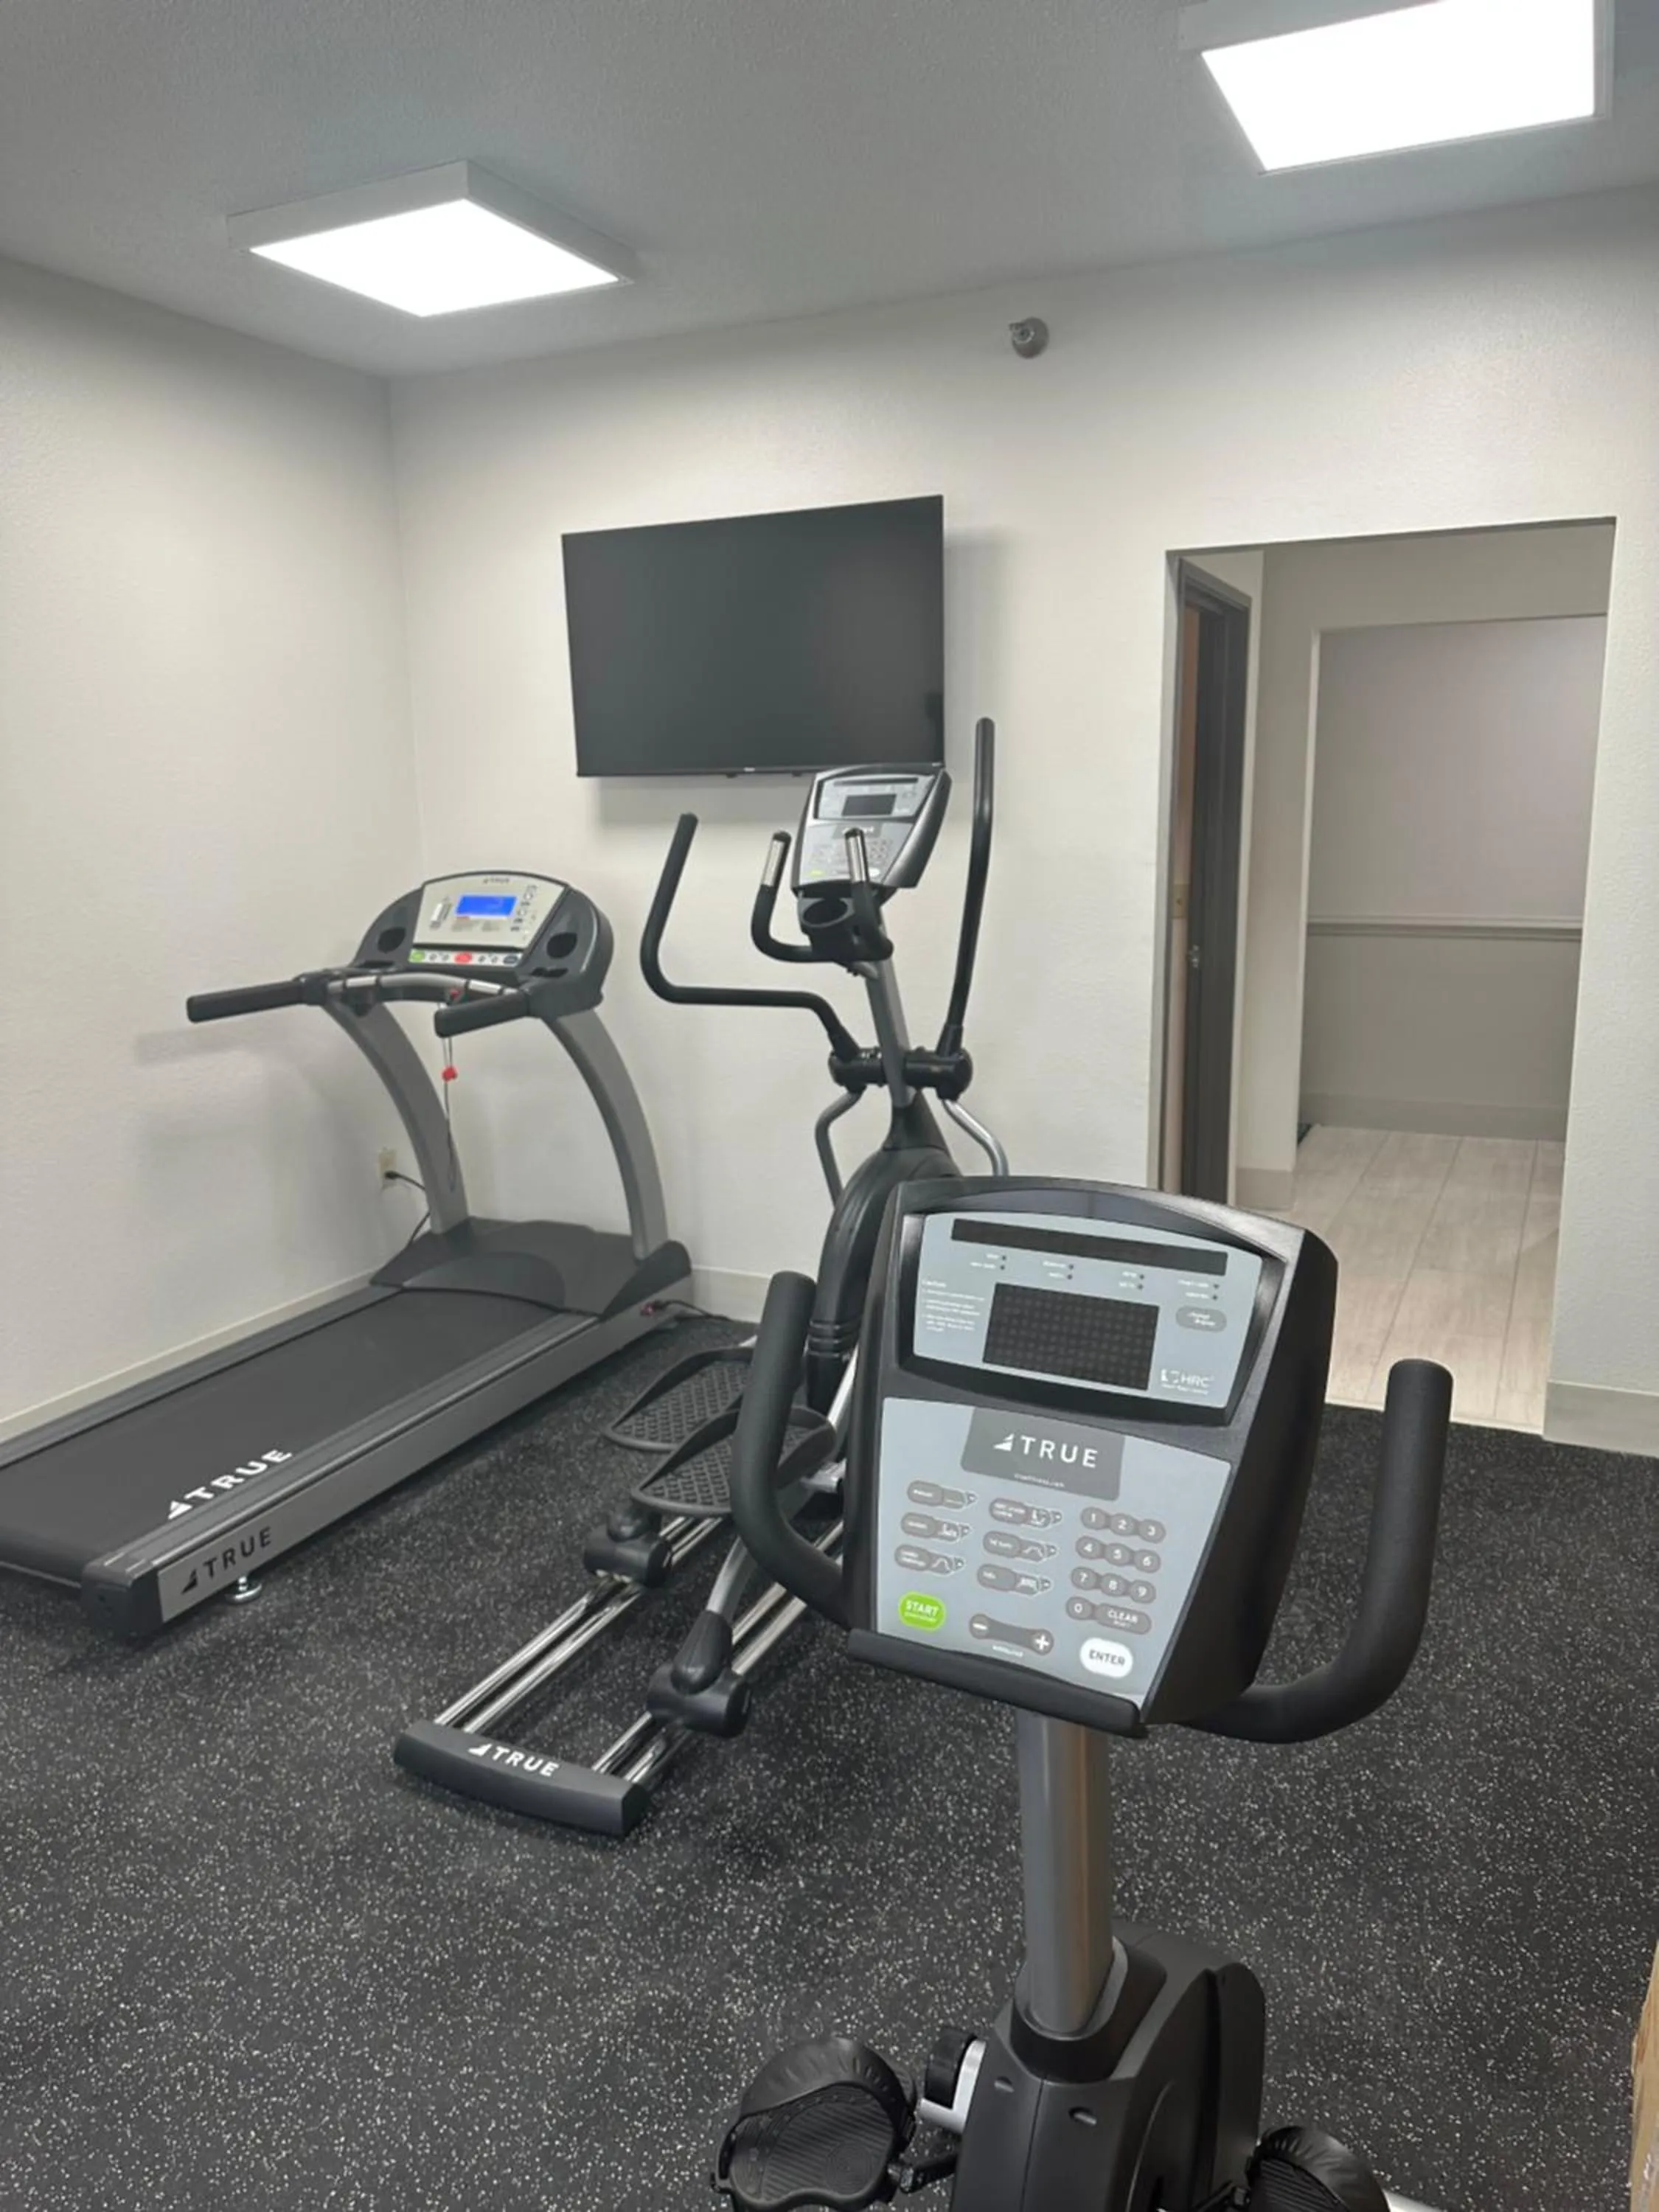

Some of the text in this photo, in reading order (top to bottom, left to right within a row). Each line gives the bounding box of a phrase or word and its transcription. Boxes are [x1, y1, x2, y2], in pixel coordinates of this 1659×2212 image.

[1180, 1373, 1210, 1387] HRC
[1020, 1434, 1099, 1469] TRUE
[184, 1447, 293, 1501] TRUE
[1118, 1519, 1127, 1530] 2
[1147, 1526, 1156, 1536] 3
[203, 1526, 274, 1579] TRUE
[1083, 1543, 1152, 1566] 4 5 6
[1079, 1572, 1147, 1597] 7 8 9
[905, 1599, 939, 1618] START
[1074, 1603, 1082, 1613] 0
[1107, 1609, 1138, 1624] CLEAR
[1088, 1649, 1126, 1667] ENTER
[491, 1745, 561, 1778] TRUE
